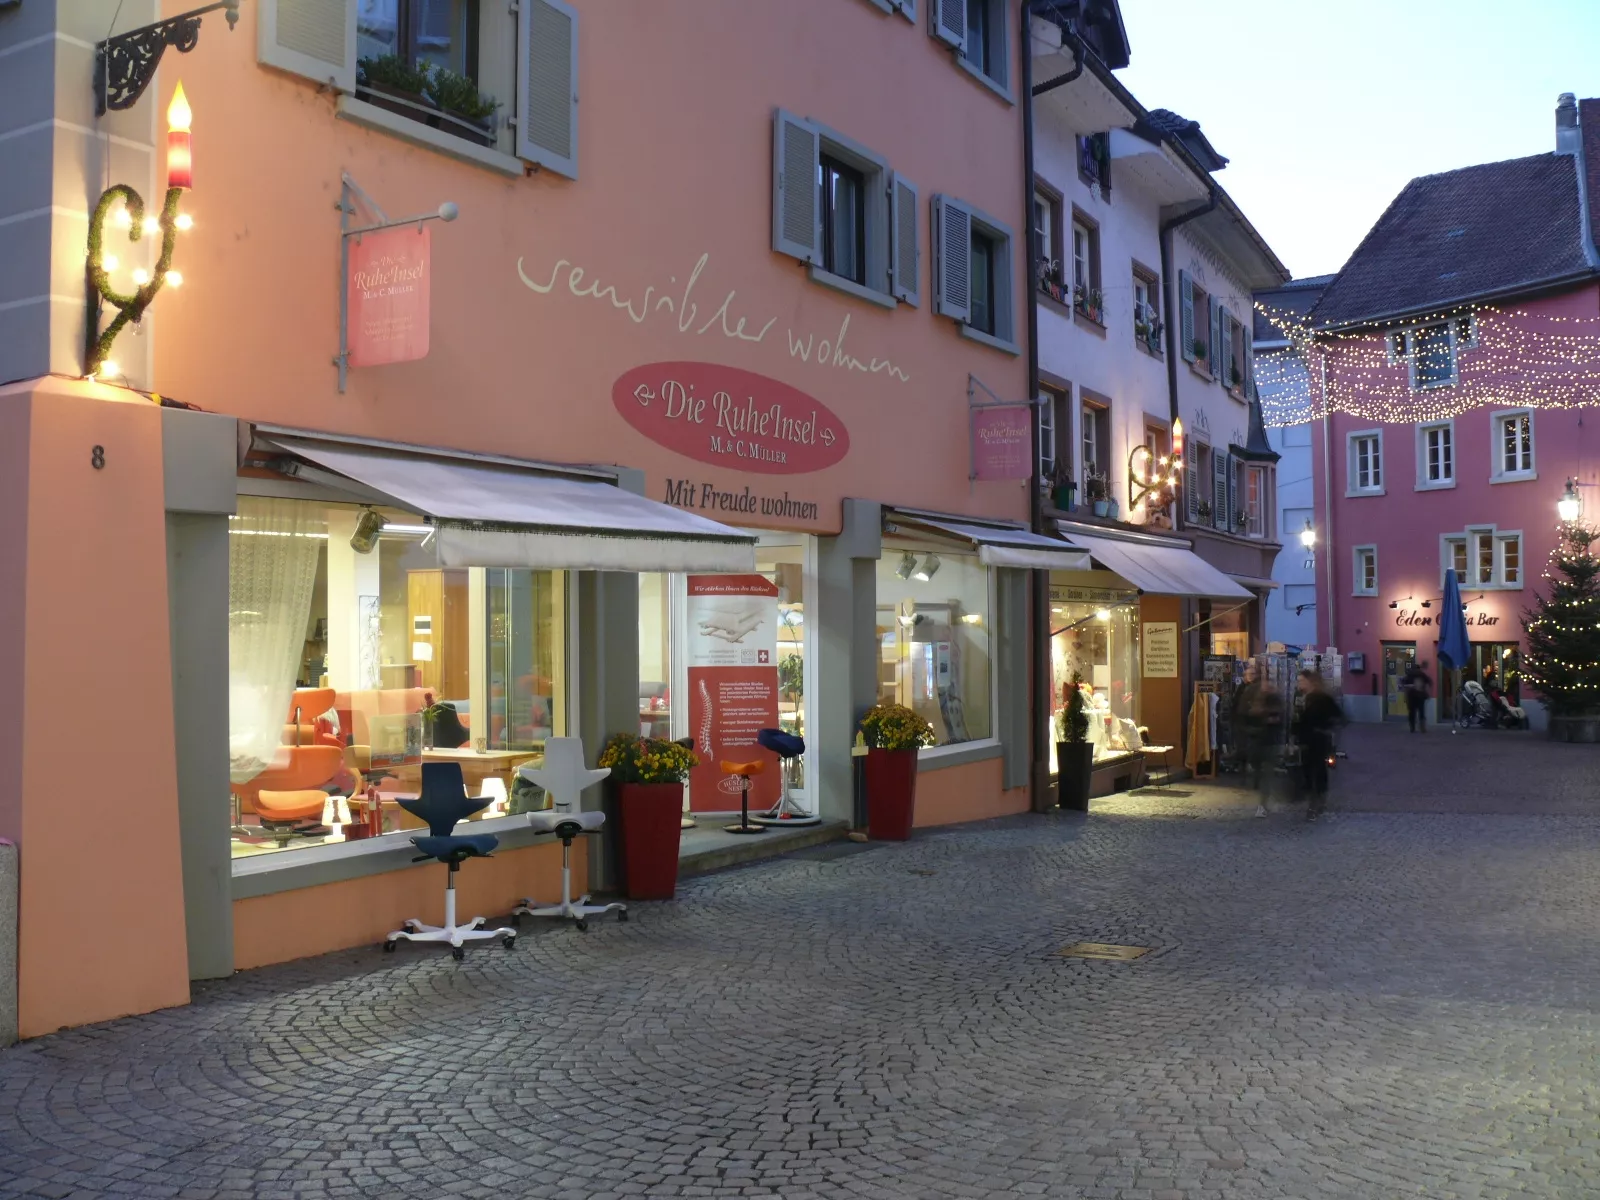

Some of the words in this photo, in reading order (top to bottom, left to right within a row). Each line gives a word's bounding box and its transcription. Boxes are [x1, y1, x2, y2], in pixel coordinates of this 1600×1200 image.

[788, 313, 910, 383] wohnen
[661, 380, 706, 424] Die
[712, 391, 817, 446] RuheInsel
[91, 444, 105, 470] 8
[711, 435, 724, 454] M.
[726, 440, 733, 453] &
[736, 441, 747, 457] C.
[663, 478, 697, 508] Mit
[700, 482, 757, 515] Freude
[761, 492, 818, 520] wohnen
[1395, 609, 1432, 627] Eden
[1477, 612, 1500, 626] Bar
